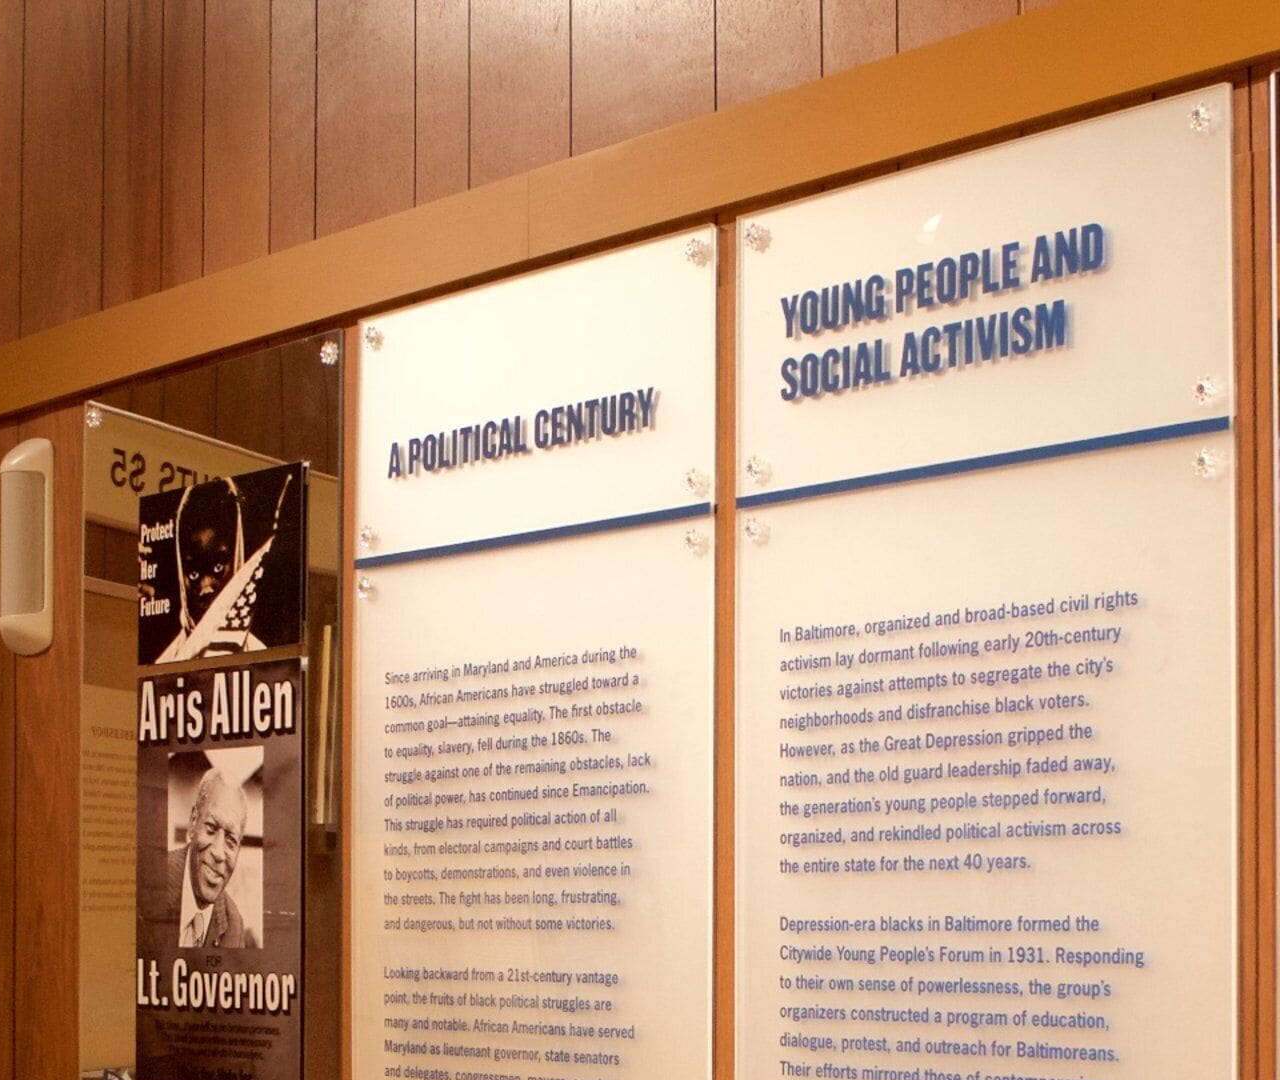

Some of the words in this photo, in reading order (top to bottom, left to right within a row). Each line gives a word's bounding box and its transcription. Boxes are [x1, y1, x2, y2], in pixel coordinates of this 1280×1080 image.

[780, 274, 885, 338] YOUNG
[895, 241, 1020, 313] PEOPLE
[1031, 223, 1105, 283] AND
[780, 338, 891, 401] SOCIAL
[899, 299, 1066, 377] ACTIVISM
[388, 442, 402, 478] A
[408, 415, 527, 474] POLITICAL
[534, 387, 655, 449] CENTURY
[141, 519, 174, 545] Protect
[140, 564, 158, 581] Her
[140, 597, 171, 617] Future
[779, 628, 791, 643] In
[793, 624, 860, 642] Baltimore,
[863, 612, 931, 636] organized
[933, 608, 961, 627] and
[963, 598, 1055, 624] broad-based
[1058, 594, 1089, 613] civil
[1093, 590, 1139, 612] rights
[384, 672, 410, 685] Since
[412, 668, 450, 683] arriving
[451, 667, 461, 678] in
[463, 659, 510, 679] Maryland
[512, 656, 532, 672] and
[533, 654, 578, 670] America
[581, 650, 617, 665] during
[619, 645, 637, 661] the
[779, 654, 832, 672] activism
[834, 651, 854, 670] lay
[857, 645, 915, 665] dormant
[917, 639, 980, 659] following
[982, 633, 1020, 654] early
[1023, 627, 1122, 649] 20th-century
[385, 694, 417, 710] 1600s,
[419, 692, 454, 706] African
[456, 687, 509, 703] Americans
[511, 684, 536, 698] have
[538, 676, 589, 696] struggled
[591, 672, 629, 690] toward
[632, 674, 639, 686] a
[778, 683, 833, 701] victories
[835, 678, 885, 699] against
[887, 673, 949, 692] attempts
[950, 671, 966, 686] to
[969, 664, 1043, 687] segregate
[1046, 661, 1071, 678] the
[1074, 657, 1114, 678] city's
[139, 676, 203, 742] Aris
[210, 670, 293, 735] Allen
[384, 721, 425, 734] common
[426, 714, 501, 734] goal—attaining
[503, 708, 546, 726] equality.
[548, 705, 569, 720] The
[571, 703, 593, 718] first
[595, 699, 642, 716] obstacle
[778, 708, 874, 732] neighborhoods
[876, 705, 903, 723] and
[905, 699, 991, 720] disfranchise
[994, 694, 1035, 714] black
[1038, 694, 1090, 710] voters.
[384, 747, 393, 759] to
[395, 744, 435, 760] equality,
[438, 742, 475, 756] slavery,
[477, 737, 493, 752] fell
[495, 735, 529, 752] during
[530, 734, 548, 748] the
[551, 730, 588, 747] 1860s.
[591, 728, 612, 743] The
[778, 743, 836, 758] However,
[839, 742, 856, 755] as
[857, 737, 880, 754] the
[883, 735, 922, 752] Great
[924, 729, 1003, 751] Depression
[1006, 724, 1064, 748] gripped
[1067, 723, 1093, 740] the
[778, 916, 876, 935] Depression-era
[879, 916, 924, 932] blacks
[927, 916, 941, 932] in
[943, 915, 1013, 932] Baltimore
[1016, 915, 1071, 932] formed
[1074, 915, 1100, 932] the
[778, 944, 832, 964] Citywide
[835, 945, 876, 965] Young
[878, 945, 935, 965] People's
[938, 946, 985, 963] Forum
[988, 947, 1002, 963] in
[1007, 946, 1050, 964] 1931.
[1054, 946, 1145, 969] Responding
[137, 958, 168, 1006] Lt.
[172, 958, 295, 1012] Governor
